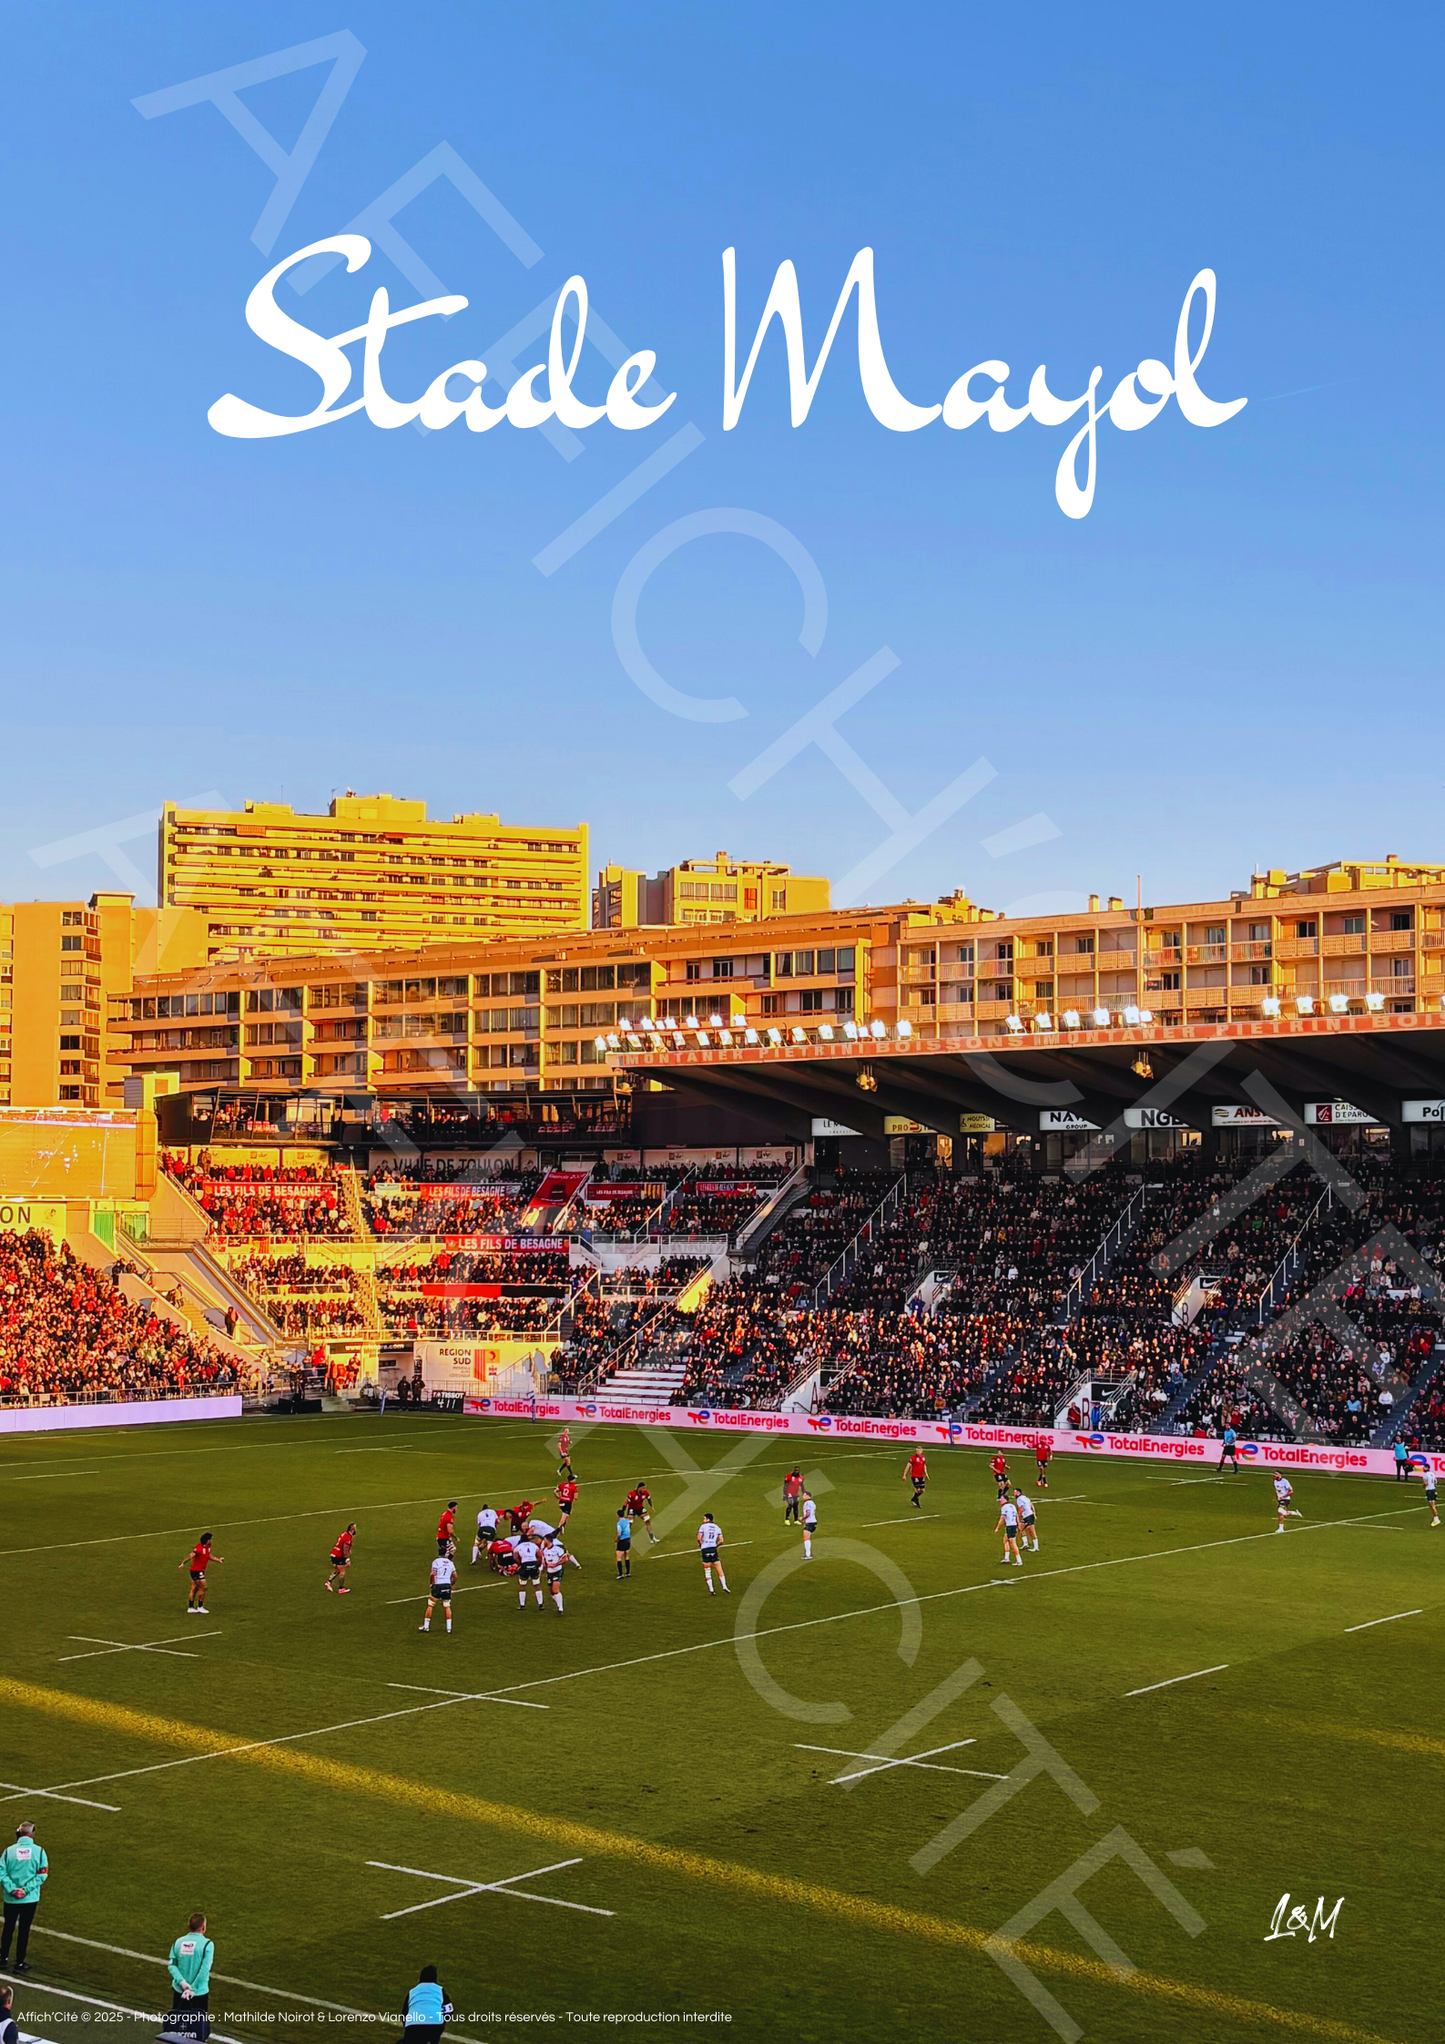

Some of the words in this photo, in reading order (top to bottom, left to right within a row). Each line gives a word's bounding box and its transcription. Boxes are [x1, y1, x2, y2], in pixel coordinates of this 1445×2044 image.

[623, 1048, 744, 1066] MONTANER
[759, 1043, 865, 1060] PIETRINI
[875, 1035, 1024, 1054] BOISSONS
[1216, 1017, 1357, 1037] PIETRINI
[214, 1186, 232, 1197] LES
[235, 1186, 256, 1197] FILS
[258, 1186, 271, 1197] DE
[274, 1185, 321, 1197] BESAGNE
[461, 1187, 471, 1197] DE
[458, 1239, 478, 1249] LES
[480, 1239, 502, 1249] FILS
[504, 1239, 518, 1249] DE
[520, 1238, 563, 1249] BESAGNE
[453, 1357, 472, 1365] SUD
[493, 1399, 560, 1417] TotalEnergies
[599, 1405, 671, 1424] TotalEnergies
[712, 1411, 790, 1431] TotalEnergies
[834, 1417, 917, 1438] TotalEnergies
[964, 1426, 1054, 1449] TotalEnergies
[1107, 1436, 1205, 1458] TotalEnergies
[1263, 1446, 1368, 1468] TotalEnergies
